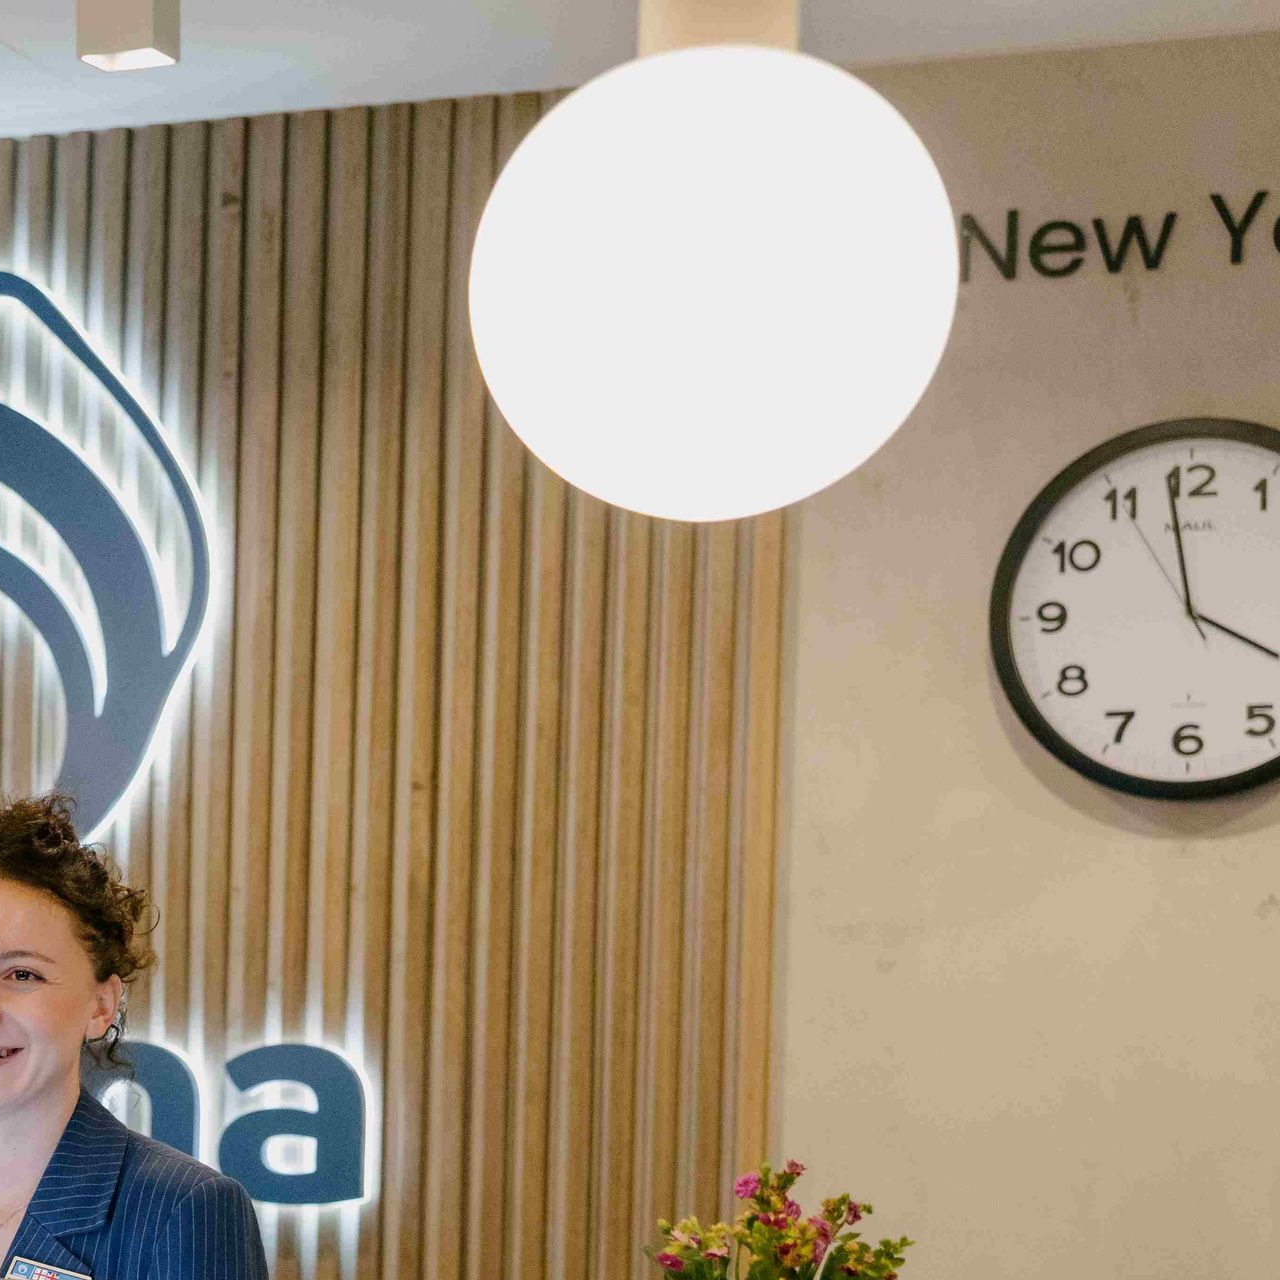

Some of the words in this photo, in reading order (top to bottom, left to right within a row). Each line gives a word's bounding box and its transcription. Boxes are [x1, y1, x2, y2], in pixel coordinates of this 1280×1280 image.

[960, 207, 1178, 282] New
[1209, 189, 1280, 267] Y
[1166, 464, 1218, 498] 12
[1253, 478, 1268, 512] 1
[1104, 486, 1138, 521] 11
[1052, 540, 1102, 573] 10
[1037, 602, 1068, 633] 9
[1056, 664, 1089, 696] 8
[1104, 710, 1136, 744] 7
[1244, 704, 1276, 737] 5
[1172, 723, 1204, 756] 6
